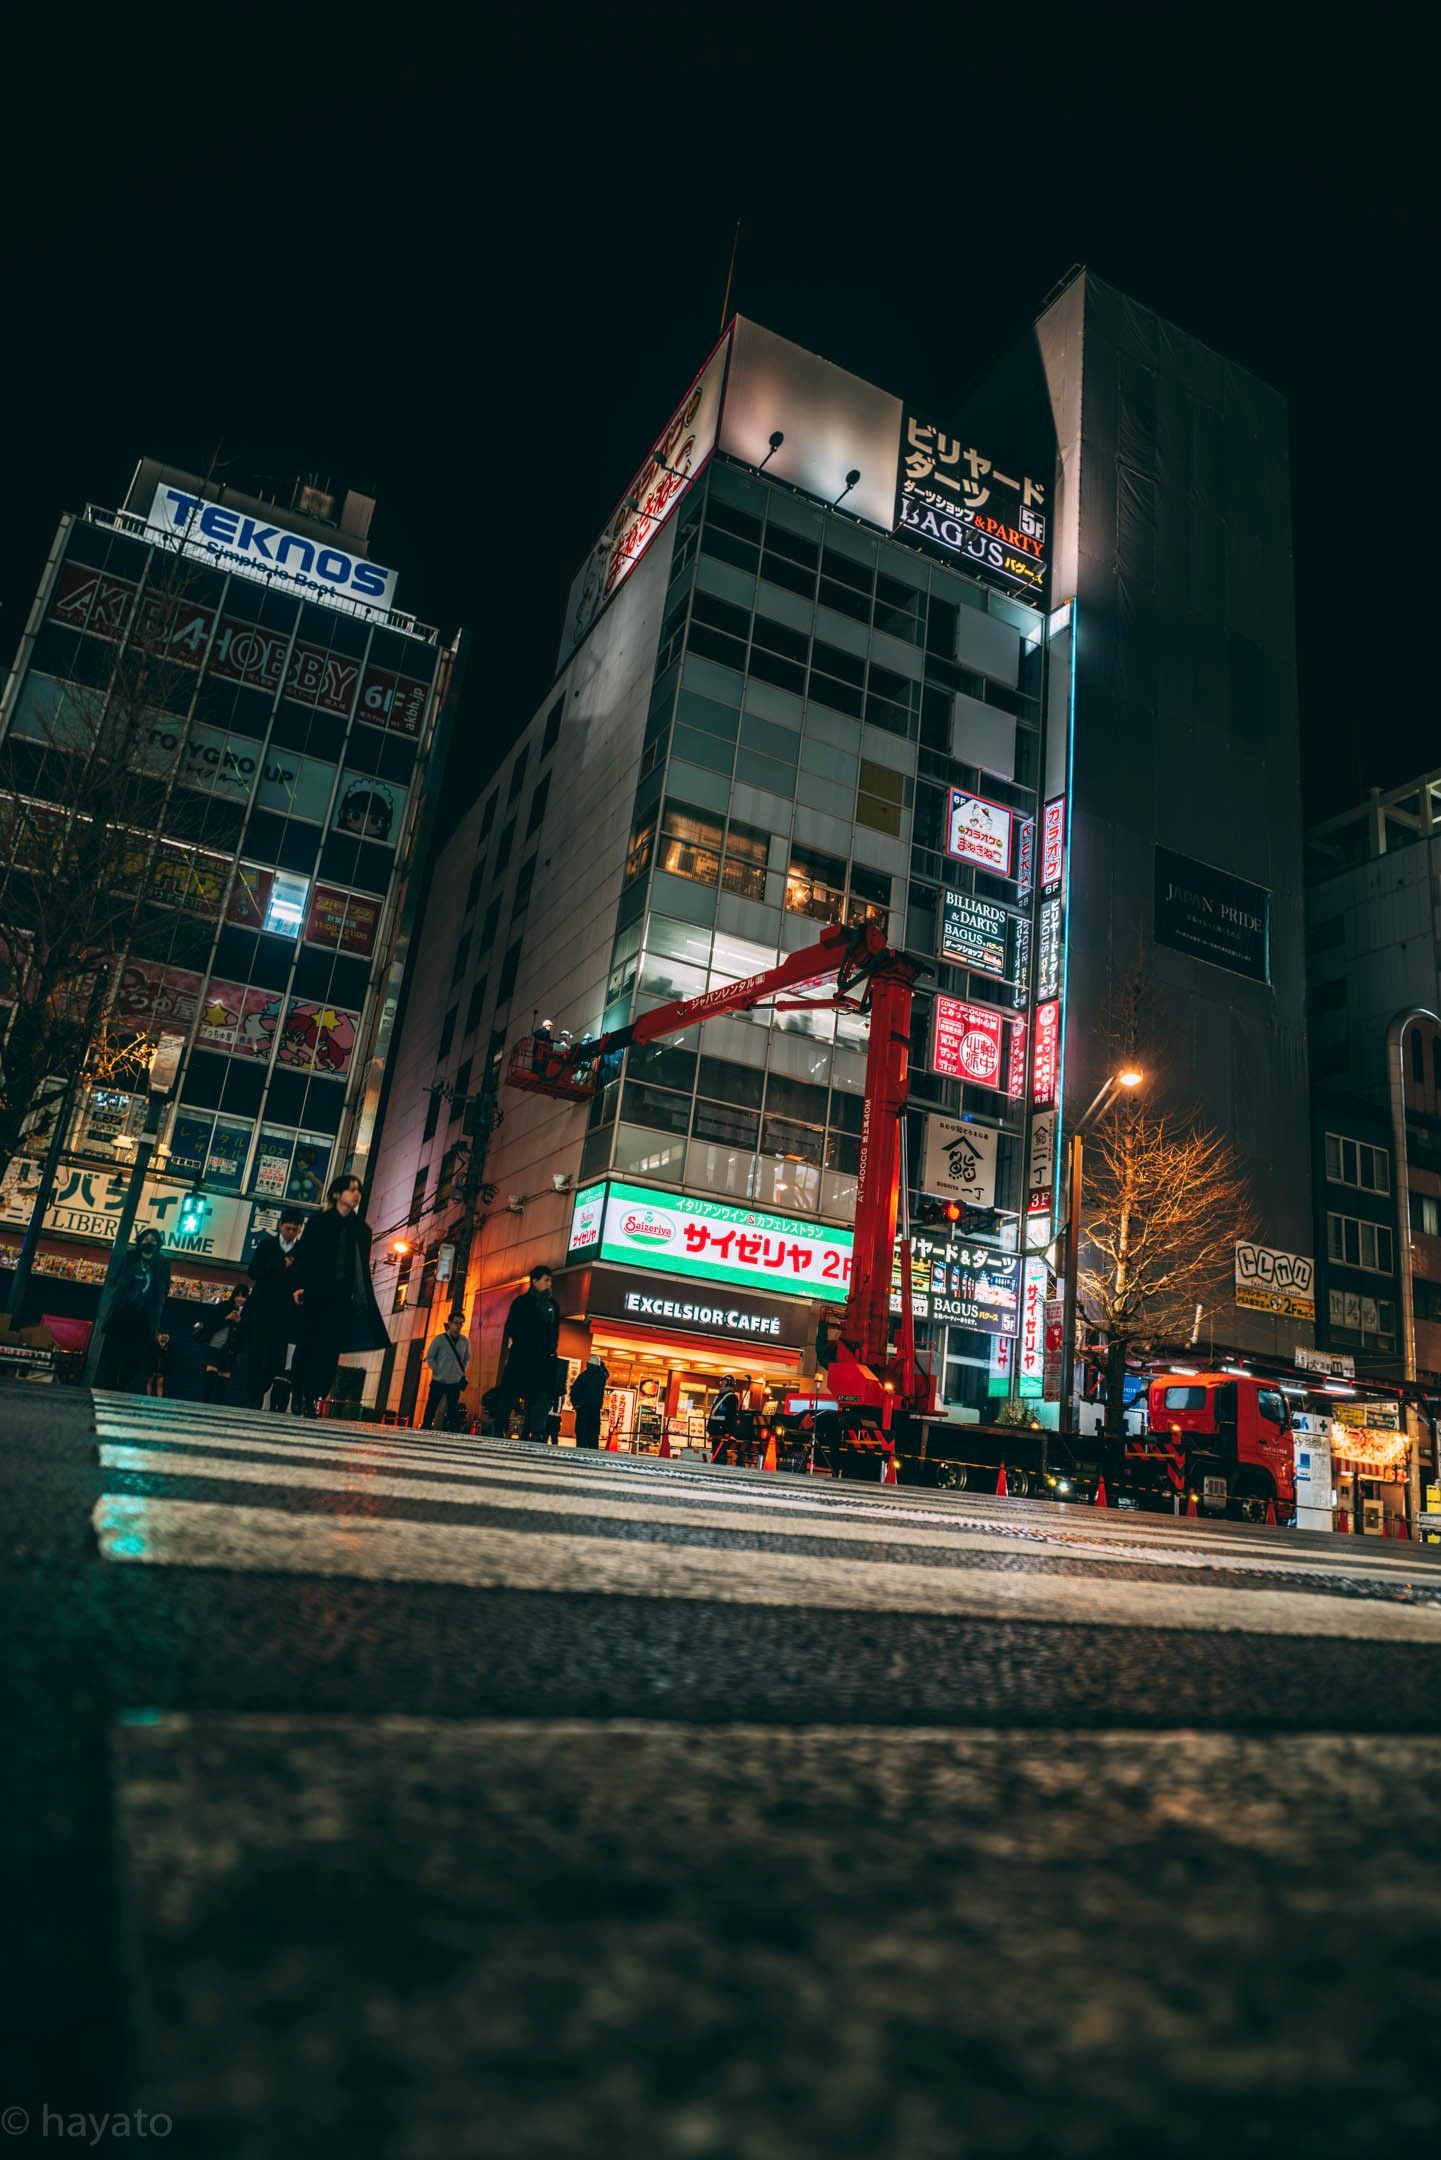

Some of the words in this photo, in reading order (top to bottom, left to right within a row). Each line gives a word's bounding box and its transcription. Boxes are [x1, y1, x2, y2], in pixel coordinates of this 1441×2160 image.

[905, 416, 1046, 508] ビリヤード
[904, 450, 991, 508] ダーツ
[904, 479, 975, 521] ダーツショップ
[165, 489, 389, 598] TEKNOS
[900, 497, 1004, 568] BAGUS
[1021, 511, 1045, 546] 5F
[953, 795, 976, 806] 6F
[957, 836, 1002, 864] まねきねこ
[965, 827, 996, 845] カラオケ
[1046, 807, 1061, 877] カラオケ
[1045, 882, 1058, 895] 6F
[946, 891, 1006, 924] BILLIARDS
[1218, 903, 1264, 934] PRIDE
[1032, 1192, 1050, 1208] 3F
[51, 1209, 147, 1241] LIBERY
[623, 1216, 672, 1239] Saizeriya
[684, 1222, 812, 1274] サイゼリヤ
[627, 1292, 725, 1325] EXCELSIOR
[934, 1297, 980, 1319] BAGUS
[1283, 1297, 1298, 1315] 2F
[1003, 1316, 1016, 1337] 5F
[1025, 1285, 1039, 1371] サイゼリヤ
